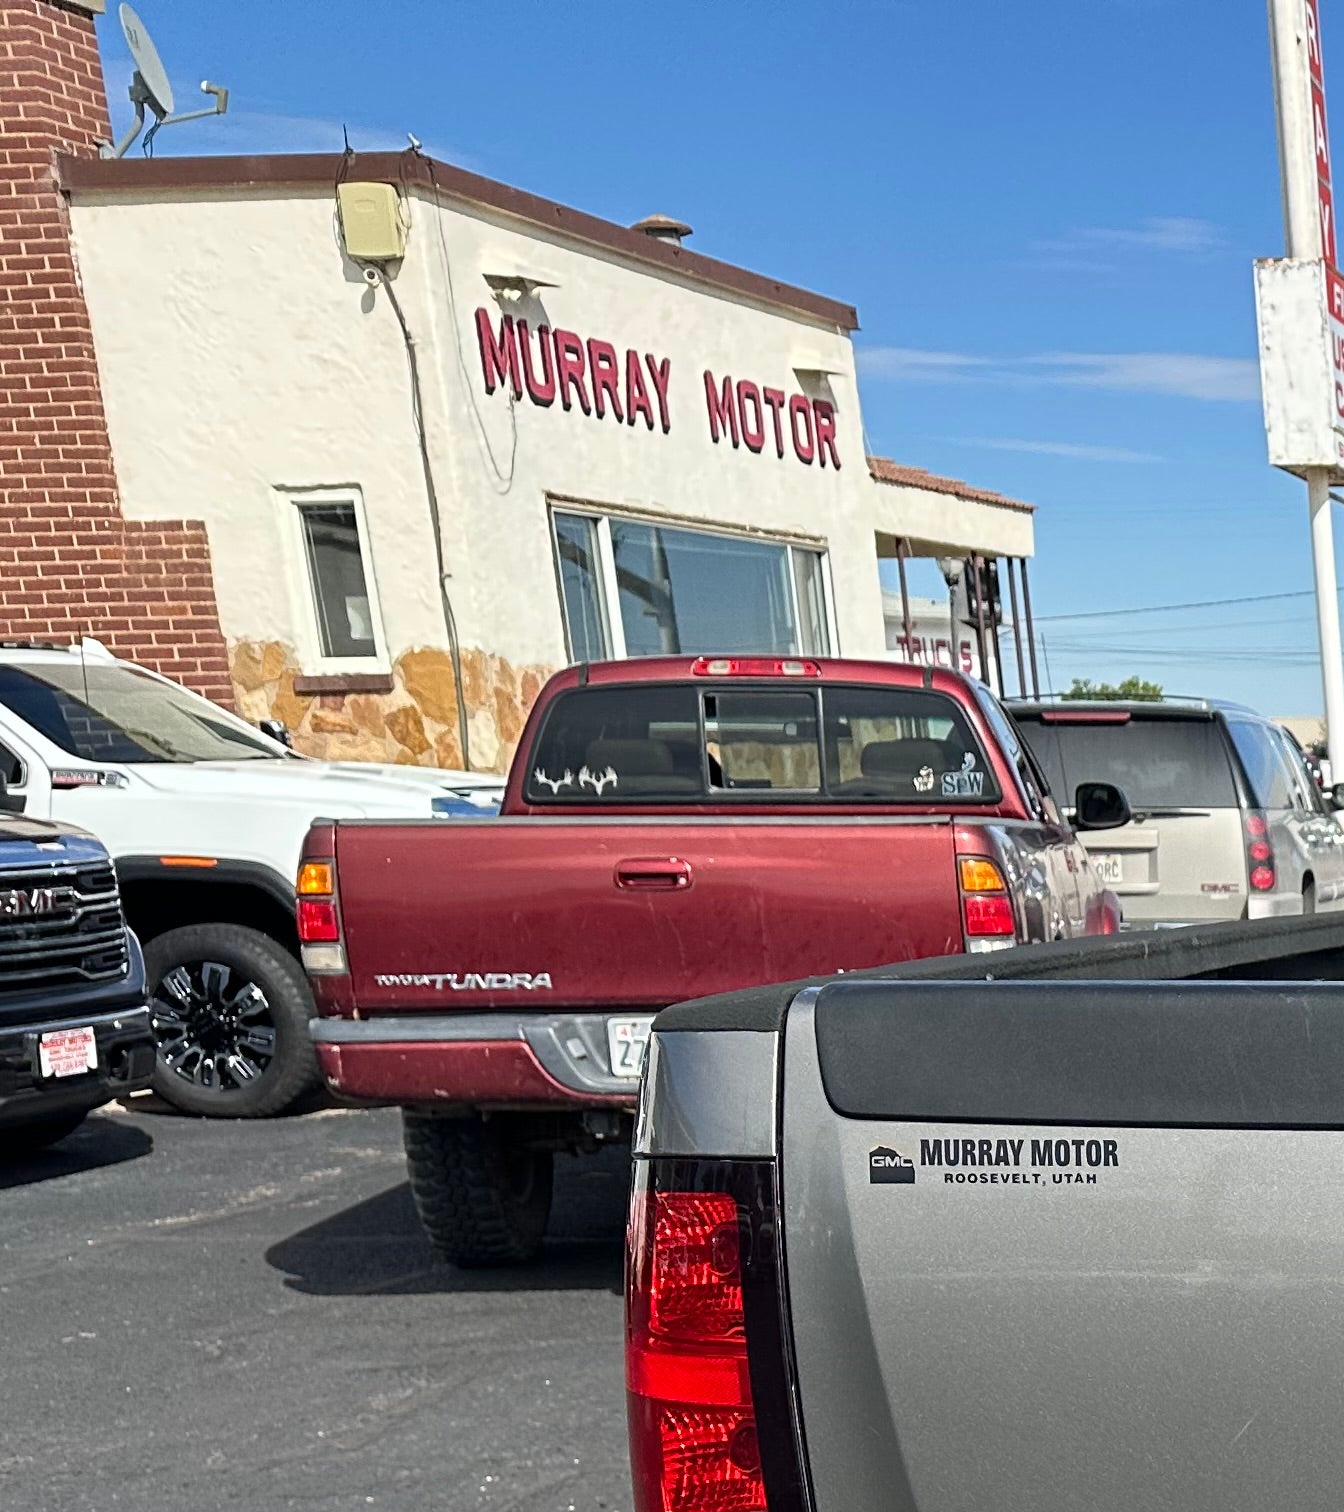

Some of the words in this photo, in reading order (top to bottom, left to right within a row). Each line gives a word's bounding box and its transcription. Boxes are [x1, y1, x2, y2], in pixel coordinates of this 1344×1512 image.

[475, 307, 670, 434] MURRAY
[703, 370, 841, 470] MOTOR
[429, 972, 552, 990] TUNDRA
[871, 1156, 913, 1167] GMC
[920, 1139, 1024, 1167] MURRAY
[1030, 1139, 1119, 1167] MOTOR
[944, 1173, 1046, 1186] ROOSEVELT,
[1052, 1173, 1097, 1184] UTAH
